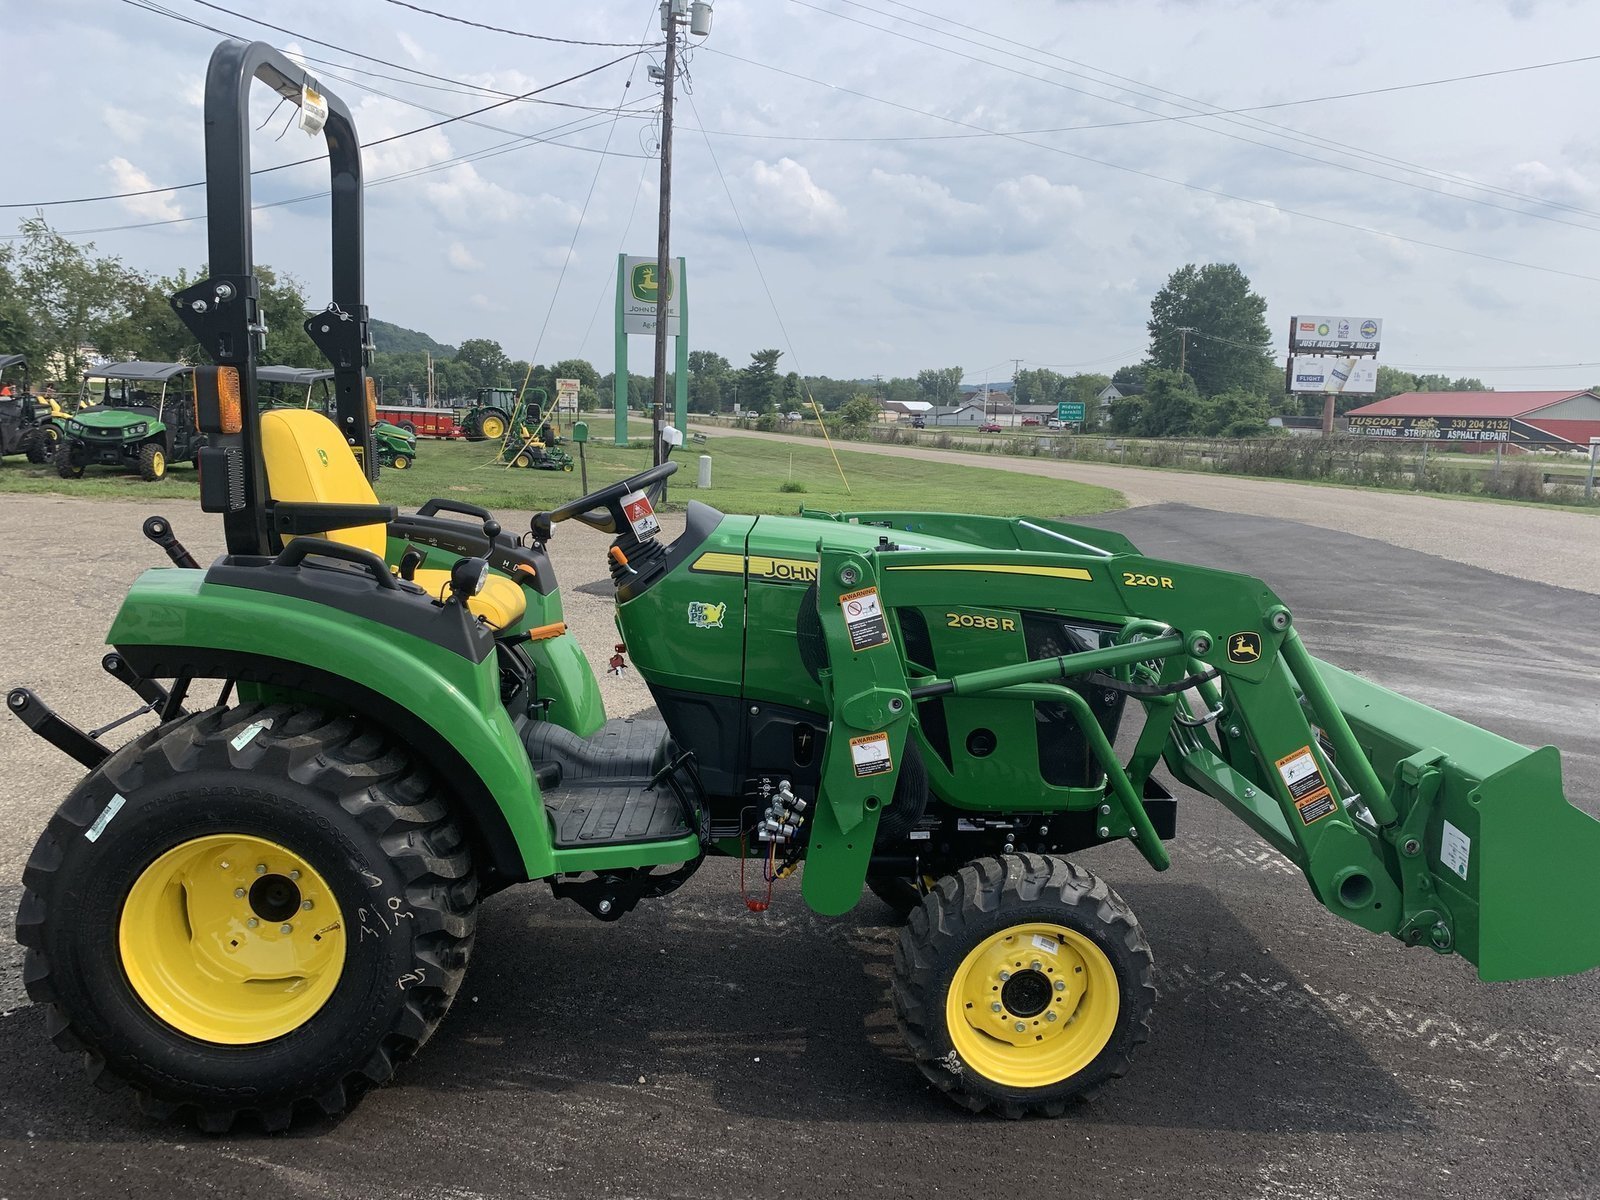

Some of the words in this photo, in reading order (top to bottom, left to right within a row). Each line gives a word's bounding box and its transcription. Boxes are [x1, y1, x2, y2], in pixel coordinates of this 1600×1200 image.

[1350, 417, 1405, 426] TUSCOAT
[1452, 419, 1466, 428] 330
[1469, 420, 1484, 429] 204
[1487, 420, 1509, 429] 2132
[1366, 428, 1397, 436] COATING
[1404, 429, 1441, 438] STRIPING
[1447, 430, 1478, 440] ASPHALT
[1481, 431, 1507, 441] REPAIR
[764, 561, 818, 581] JOHN
[1123, 573, 1158, 587] 220
[1161, 577, 1175, 590] R
[847, 588, 876, 600] WARNING
[690, 612, 708, 621] Pro
[946, 613, 999, 630] 2038
[1002, 618, 1016, 631] R
[857, 733, 886, 743] WARNING
